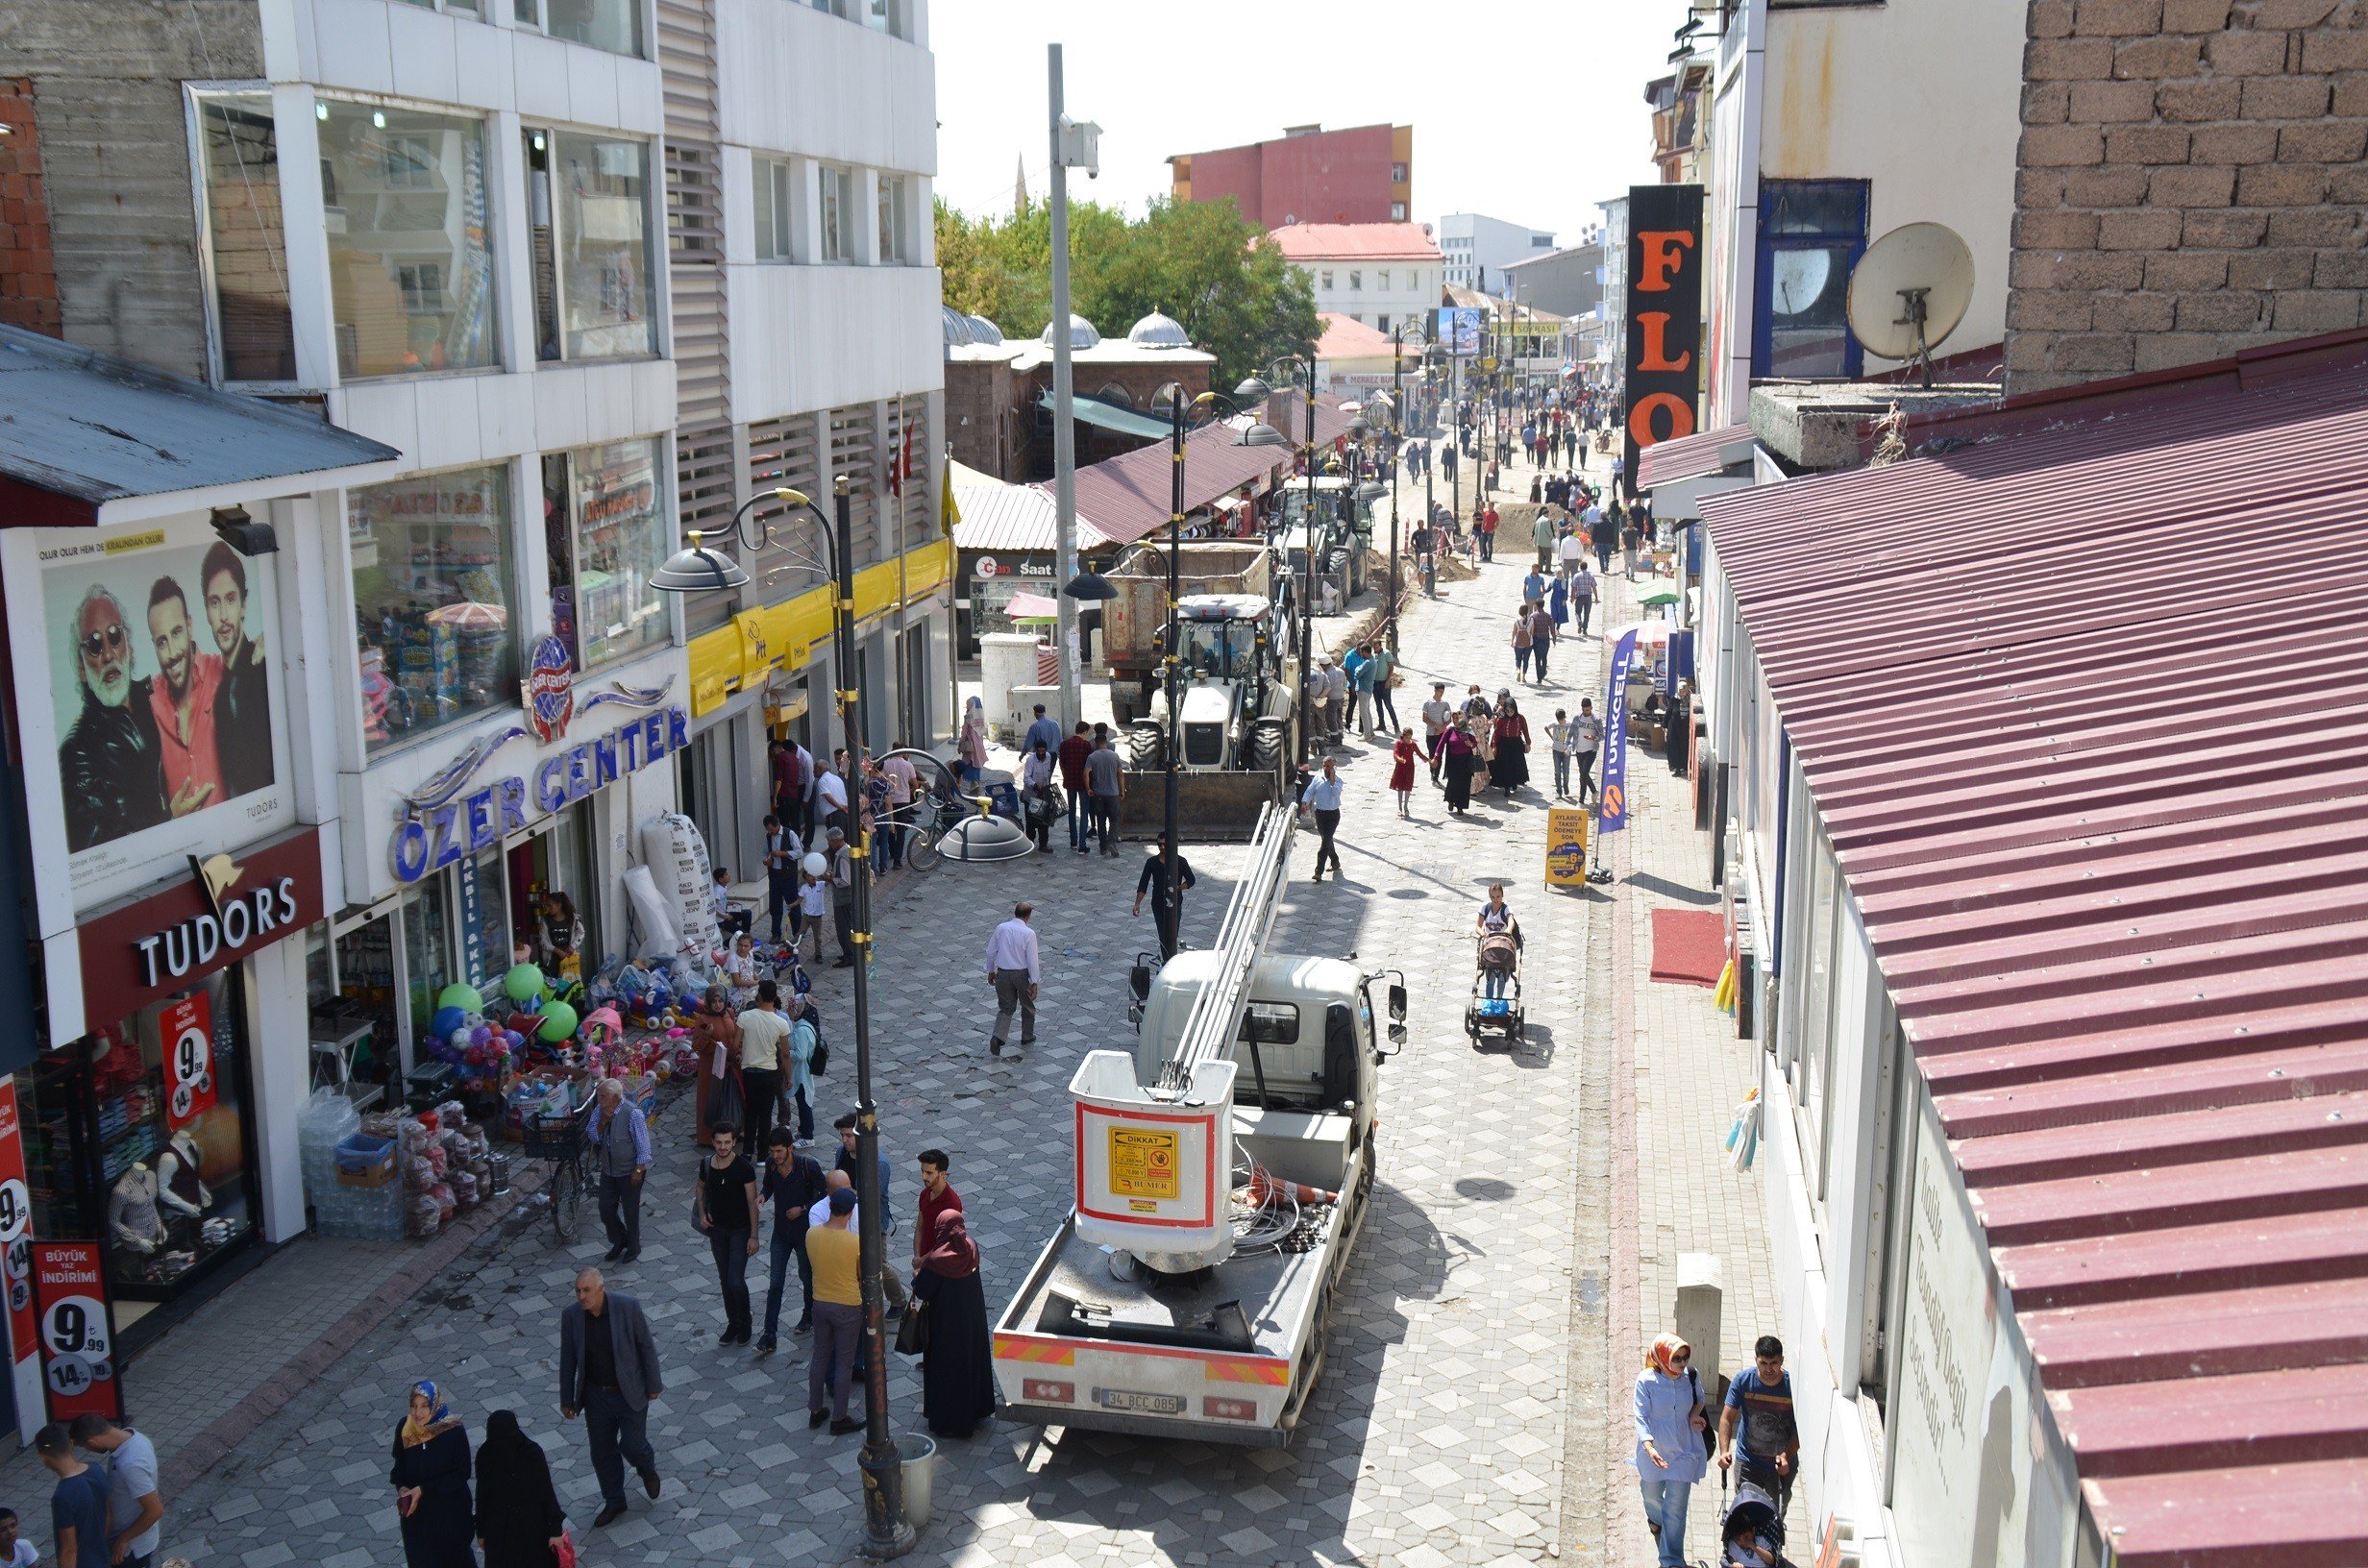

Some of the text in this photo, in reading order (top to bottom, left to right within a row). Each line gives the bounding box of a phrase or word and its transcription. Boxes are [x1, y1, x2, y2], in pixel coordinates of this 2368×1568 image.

[1628, 230, 1694, 450] FLO
[38, 550, 59, 561] OLUR
[60, 547, 79, 557] OLUR
[80, 543, 95, 554] HEM
[96, 542, 105, 552] DE
[106, 538, 143, 551] KRALINDAN
[982, 559, 1052, 576] Can Saat
[547, 670, 571, 688] CENTER
[1608, 651, 1630, 775] TURKCELL
[390, 705, 689, 883] ÖZER CENTER
[246, 798, 279, 818] TUDORS
[138, 877, 296, 988] TUDORS
[1127, 1135, 1159, 1144] DİKKAT
[1921, 1156, 1942, 1253] Kalite
[45, 1249, 88, 1262] BÜYÜK
[41, 1269, 97, 1284] İNDİRİMİ
[53, 1303, 86, 1353] 9
[1109, 1392, 1123, 1406] 34
[1128, 1395, 1149, 1409] BCC
[1154, 1397, 1175, 1410] 085
